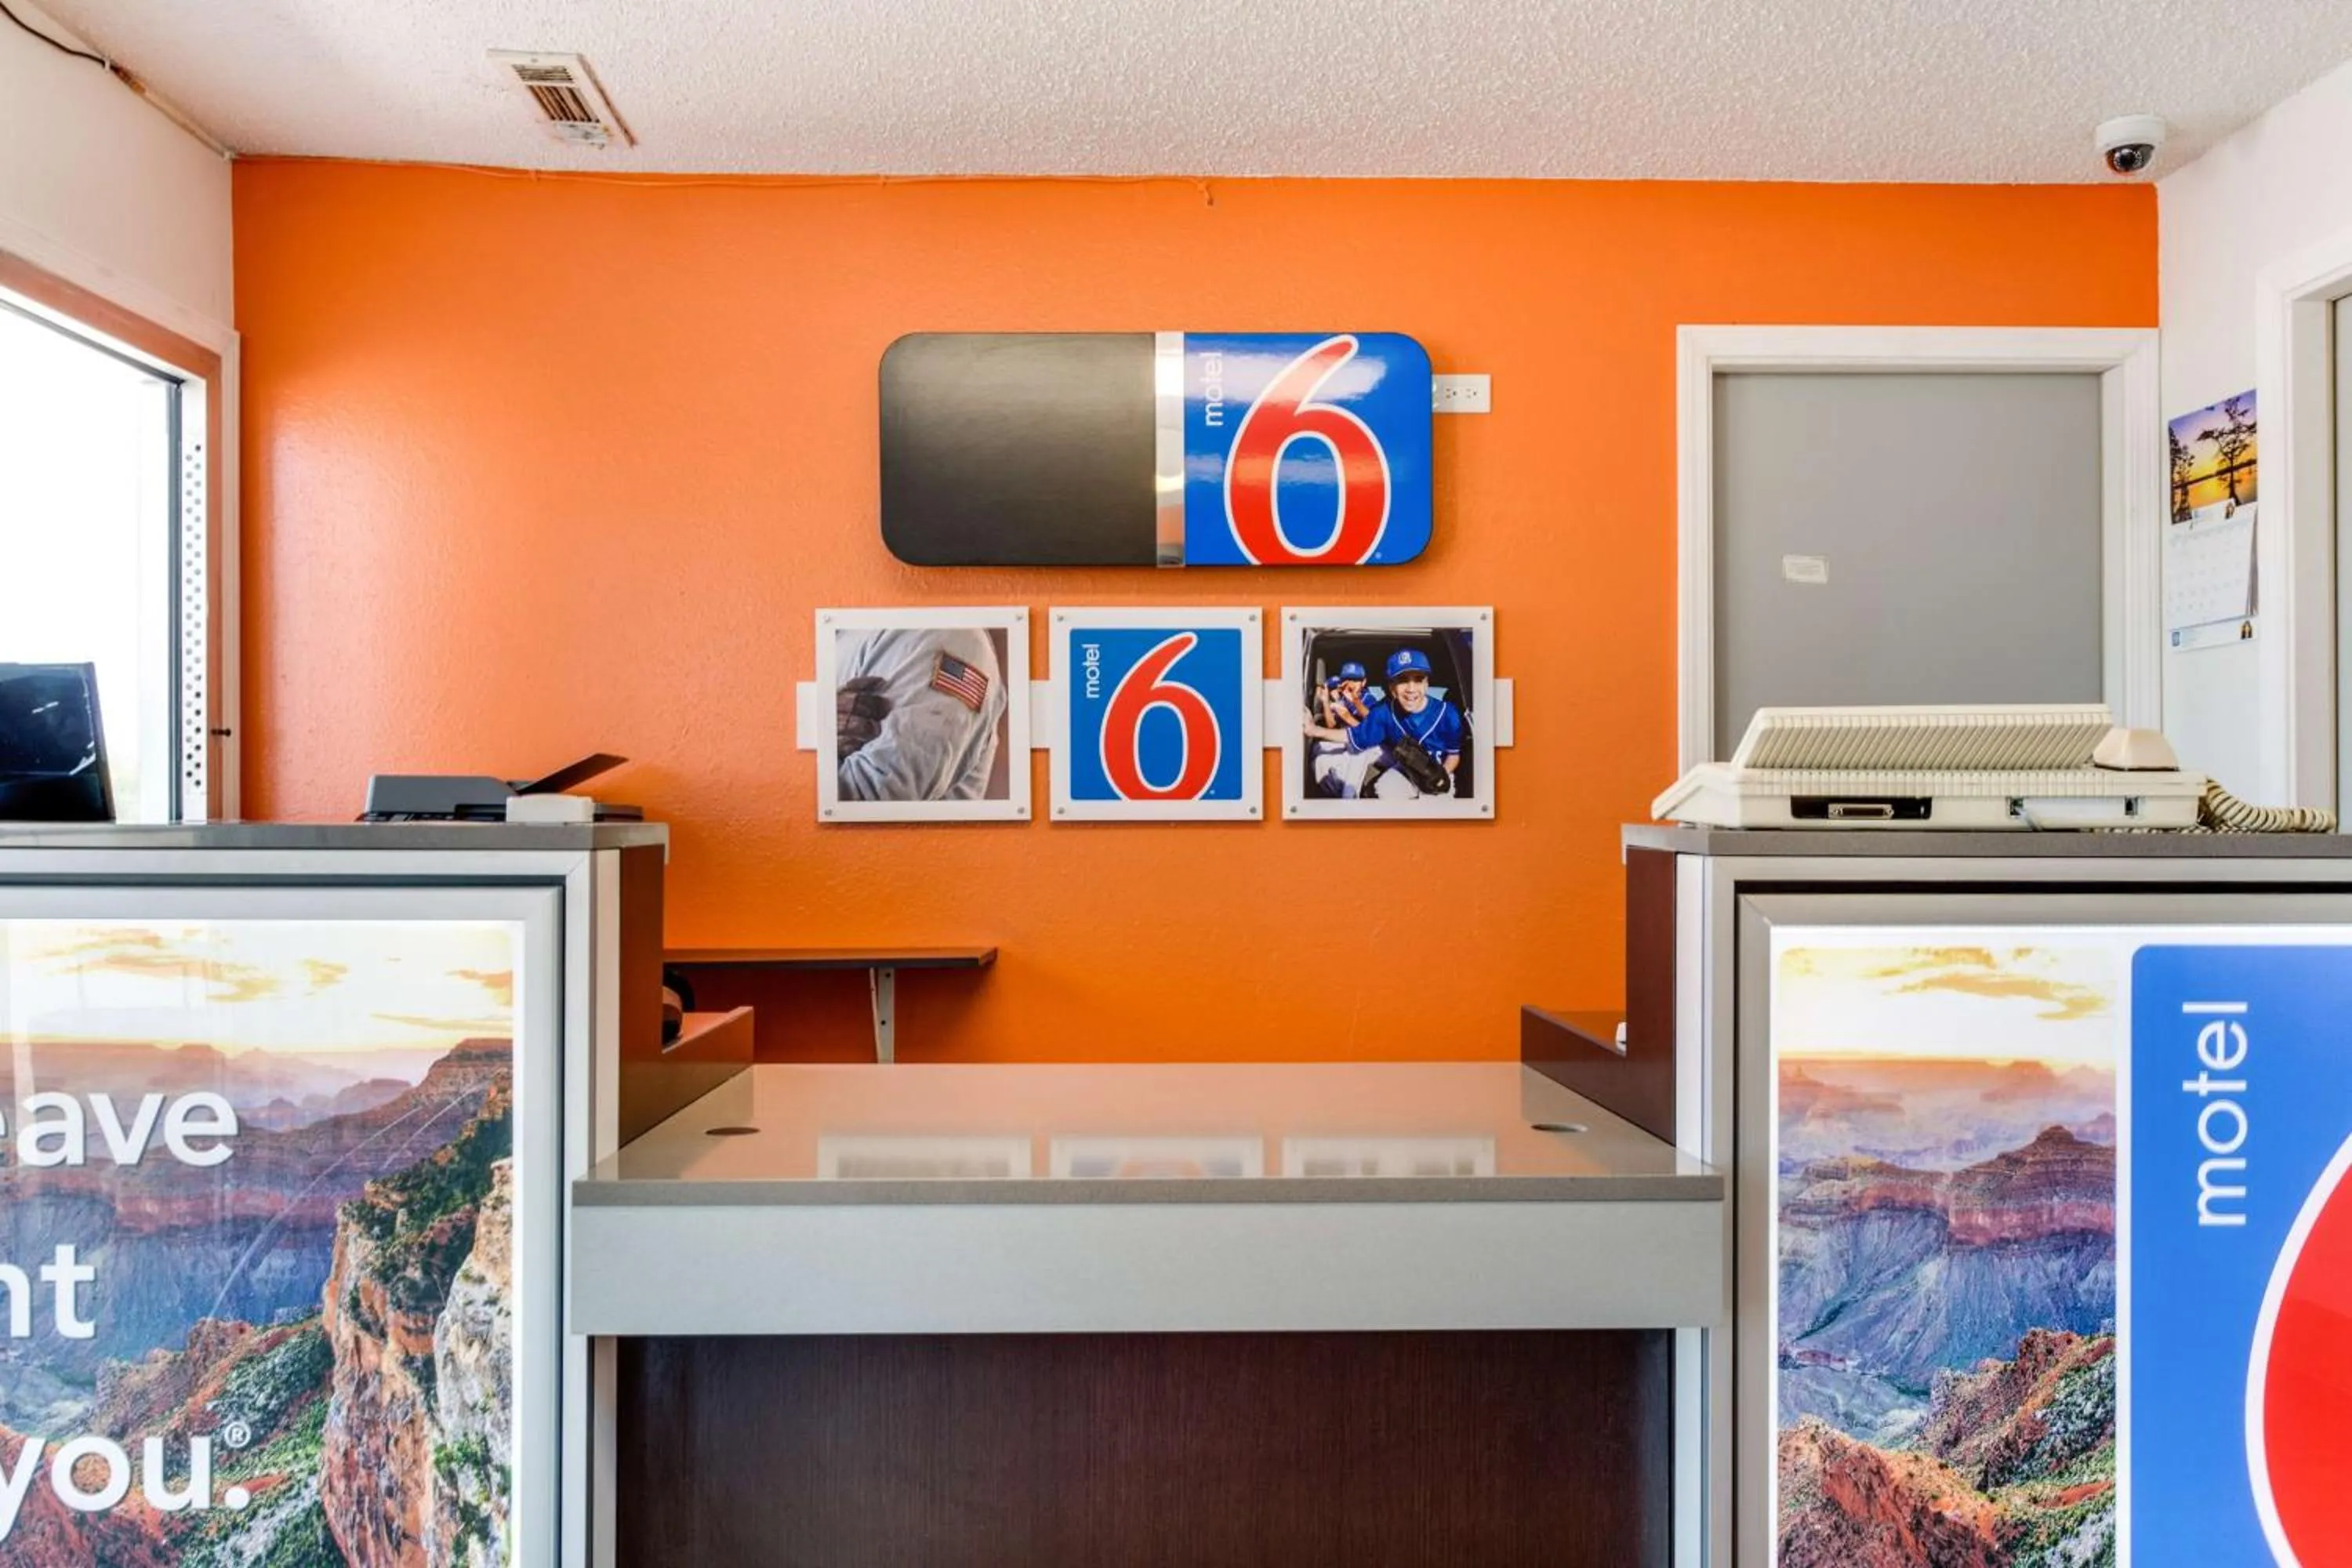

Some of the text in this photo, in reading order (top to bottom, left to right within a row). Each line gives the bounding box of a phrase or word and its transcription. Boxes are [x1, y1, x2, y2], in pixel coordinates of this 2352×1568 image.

[1199, 334, 1391, 565] motel 6
[1081, 631, 1221, 800] motel 6
[0, 1091, 239, 1167] ave
[2182, 1001, 2249, 1226] motel
